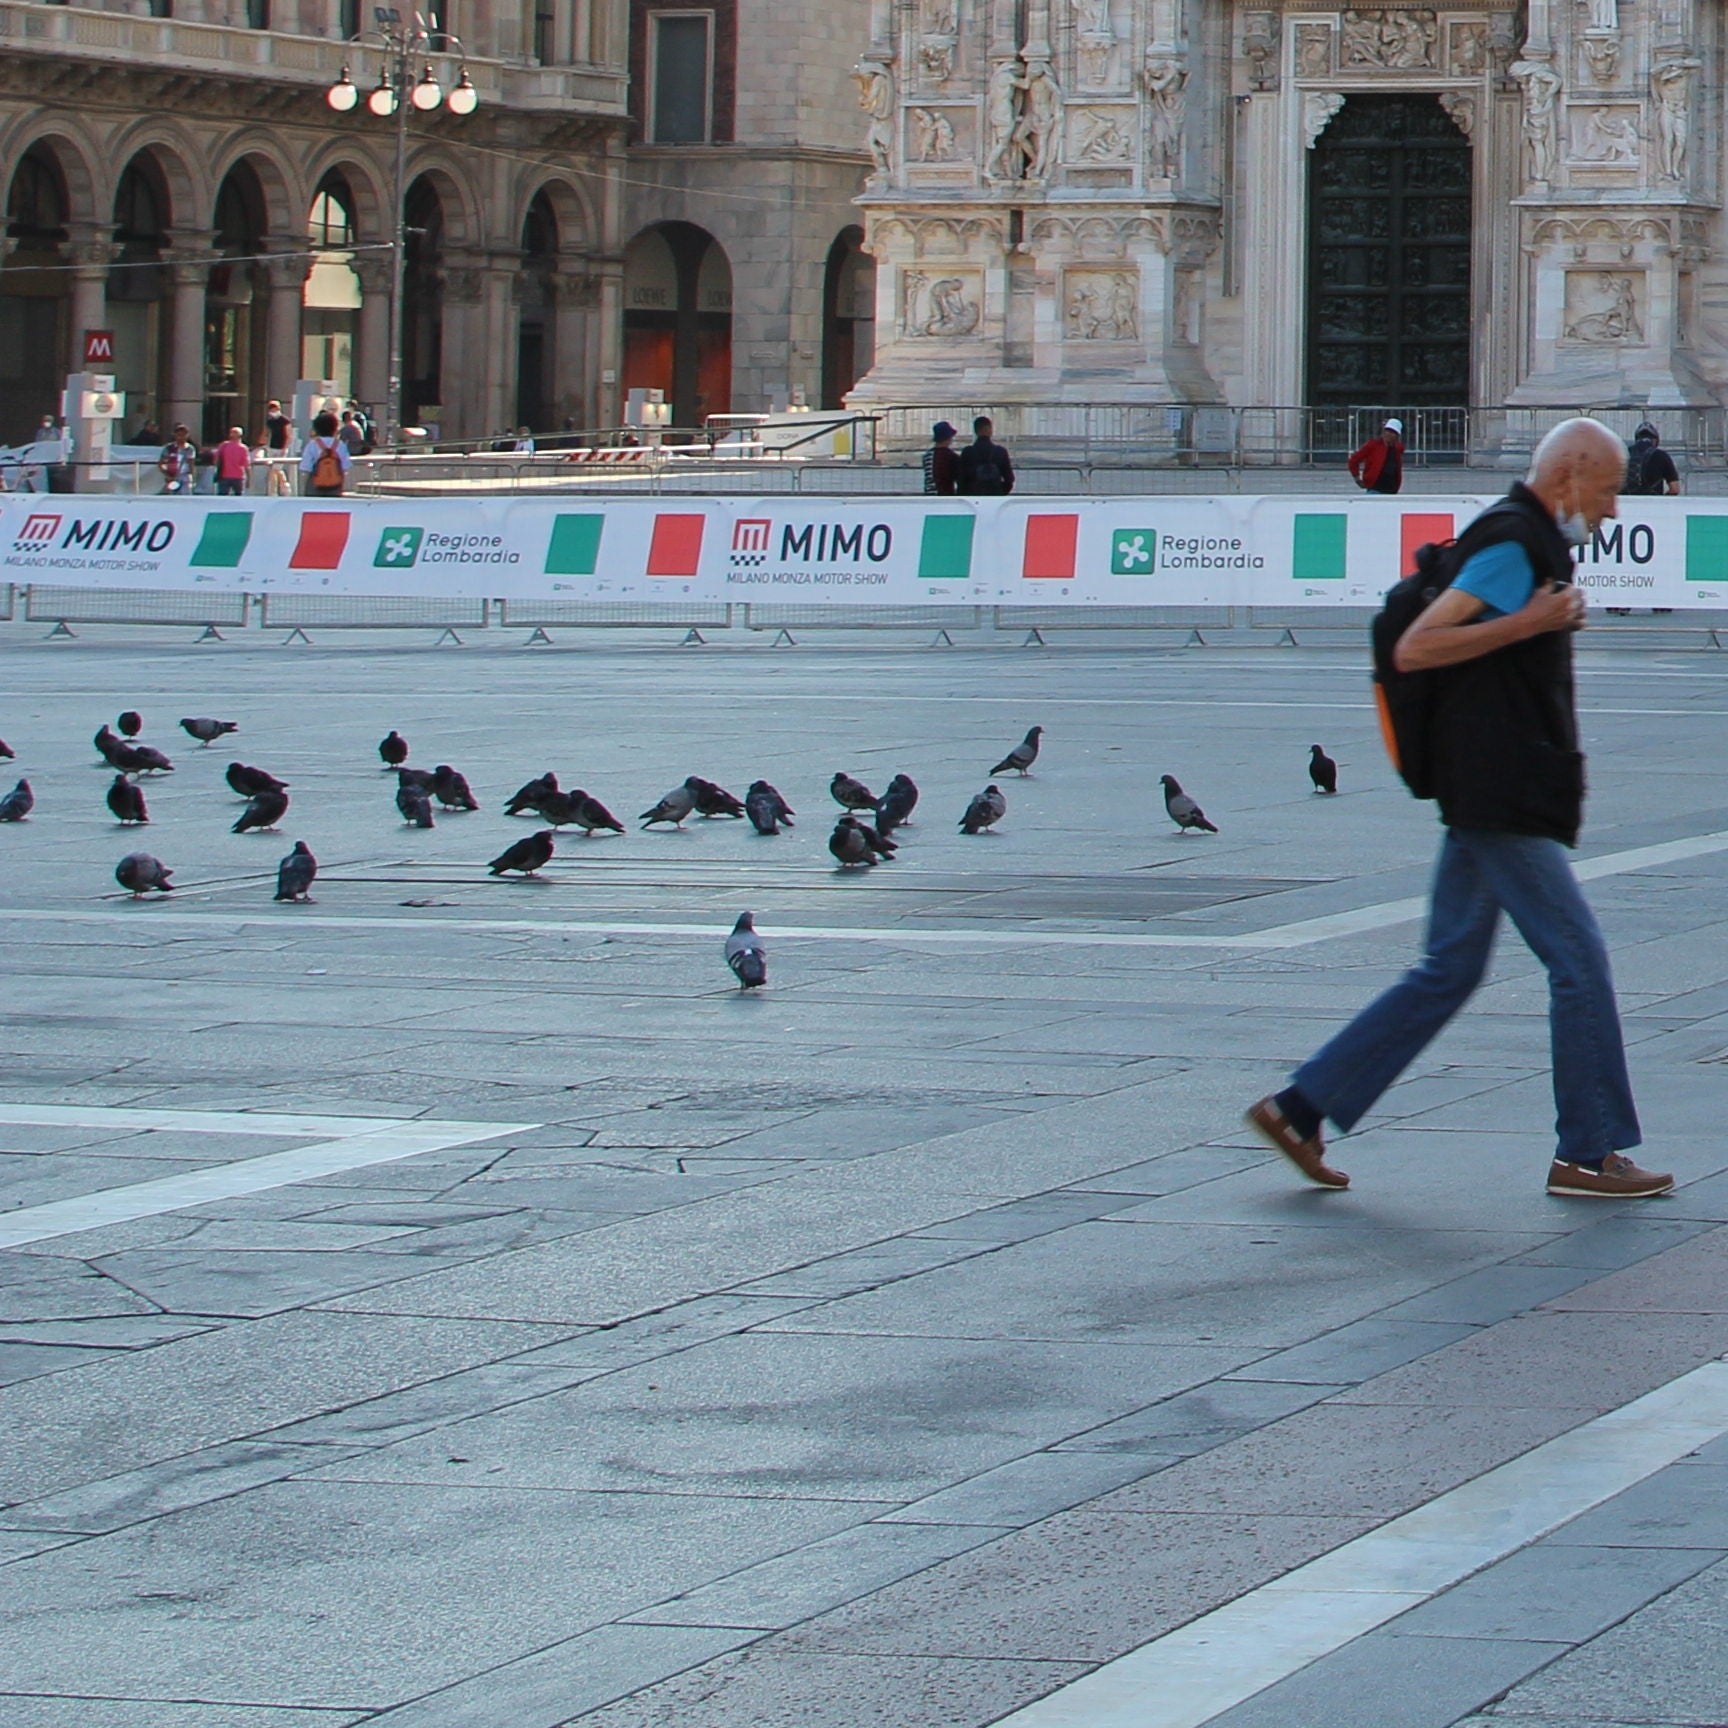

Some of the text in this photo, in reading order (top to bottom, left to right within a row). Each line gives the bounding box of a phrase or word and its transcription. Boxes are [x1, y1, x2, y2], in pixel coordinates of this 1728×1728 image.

[88, 338, 110, 356] M
[62, 519, 175, 552] MIMO
[426, 533, 502, 548] Regione
[781, 524, 892, 562] MIMO
[1162, 536, 1242, 552] Regione
[4, 557, 161, 571] MILANO MONZA MOTOR SHOW
[422, 550, 520, 564] Lombardia
[1161, 554, 1264, 569] Lombardia
[727, 573, 888, 585] MILANO MONZA MOTOR SHOW
[1578, 576, 1655, 588] MOTOR SHOW
